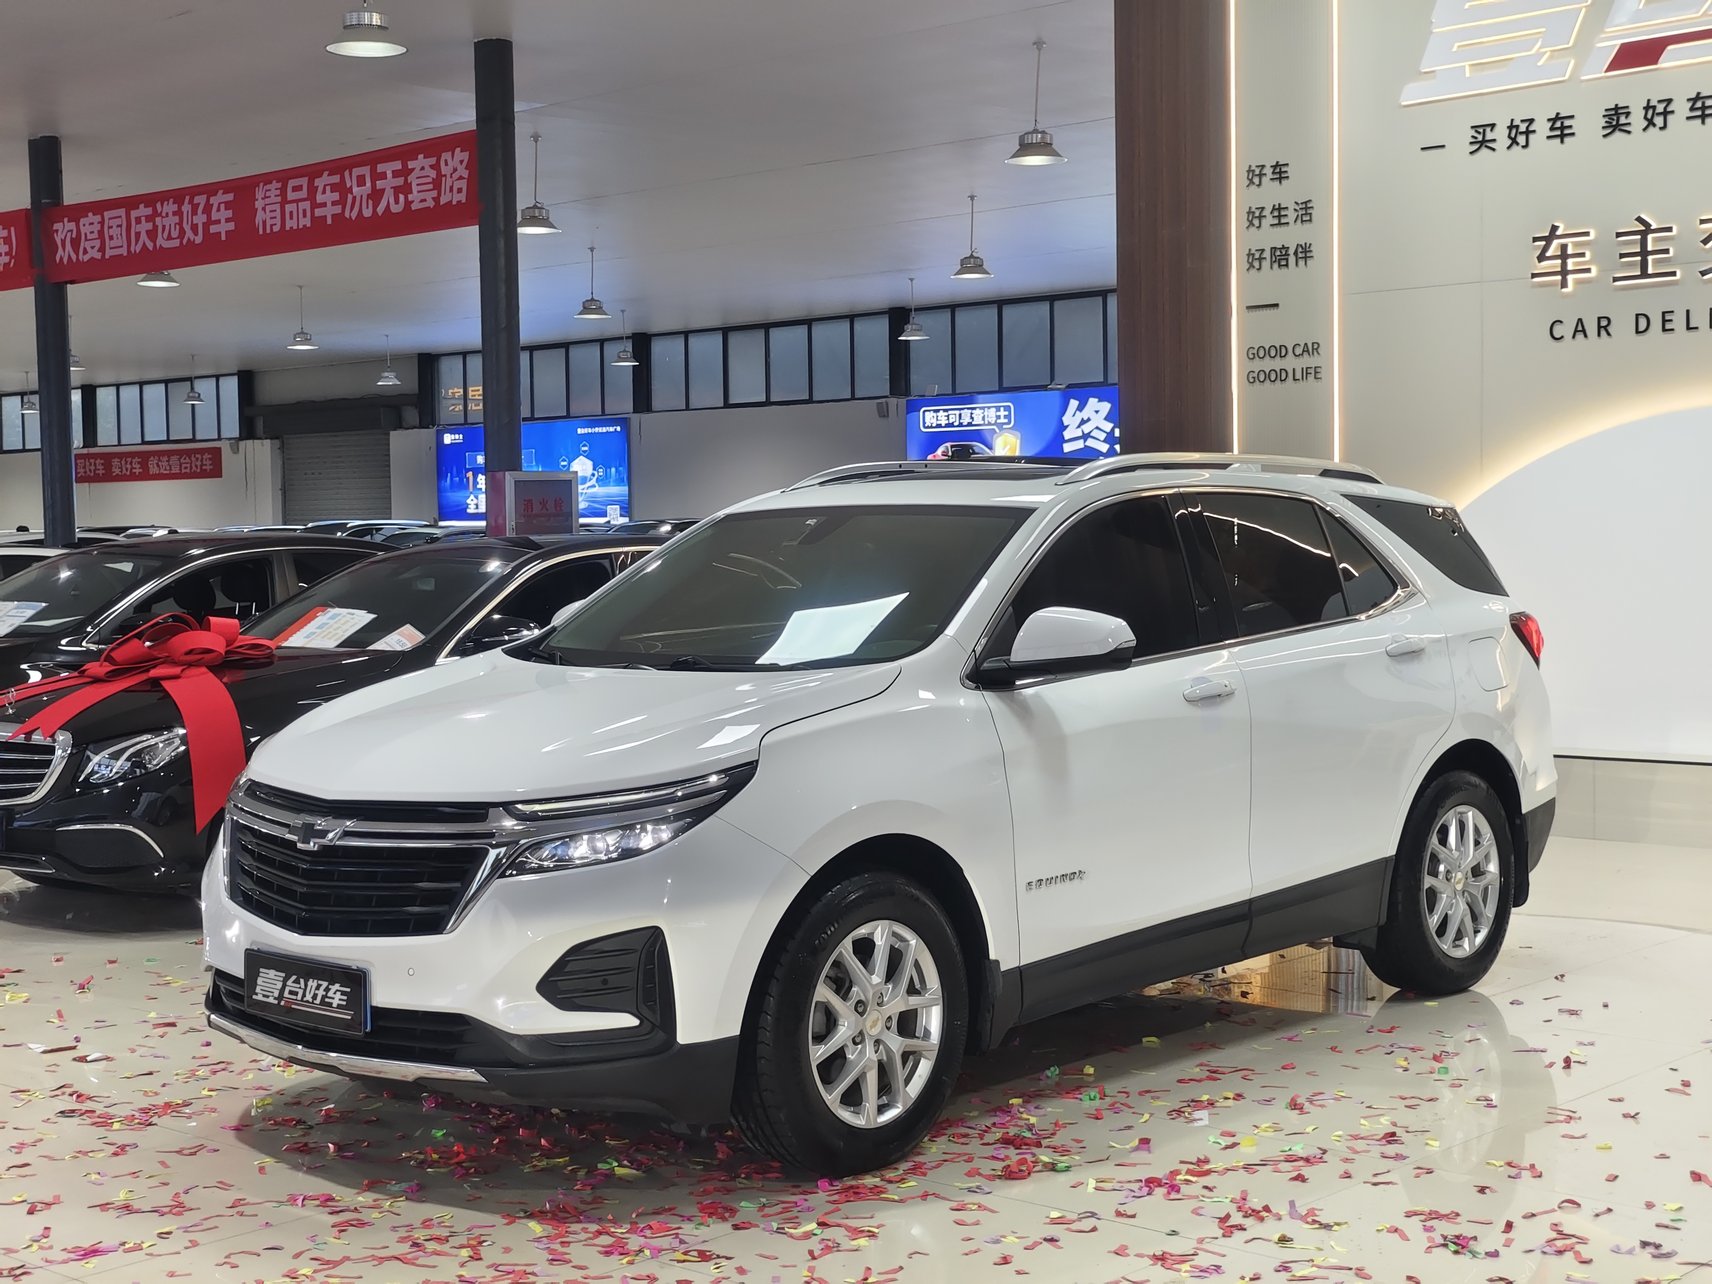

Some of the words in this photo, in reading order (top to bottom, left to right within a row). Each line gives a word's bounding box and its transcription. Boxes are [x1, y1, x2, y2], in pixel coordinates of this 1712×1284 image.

[1468, 111, 1577, 155] 买好车
[1601, 91, 1712, 138] 卖好车
[1246, 160, 1290, 188] 好车
[53, 189, 235, 265] 欢度国庆选好车
[254, 147, 470, 235] 精品车况无套路
[1246, 199, 1314, 230] 好生活
[1246, 242, 1314, 272] 好陪伴
[1530, 214, 1712, 292] 车主
[1549, 316, 1612, 341] CAR
[1246, 344, 1288, 361] GOOD
[1292, 341, 1321, 358] CAR
[1246, 368, 1288, 384] GOOD
[1292, 366, 1322, 382] LIFE
[924, 408, 1009, 427] 购车可享查博士
[1062, 397, 1120, 454] 终
[77, 457, 105, 477] 买好车
[111, 456, 143, 476] 卖好车
[252, 967, 351, 1008] 壹台好车
